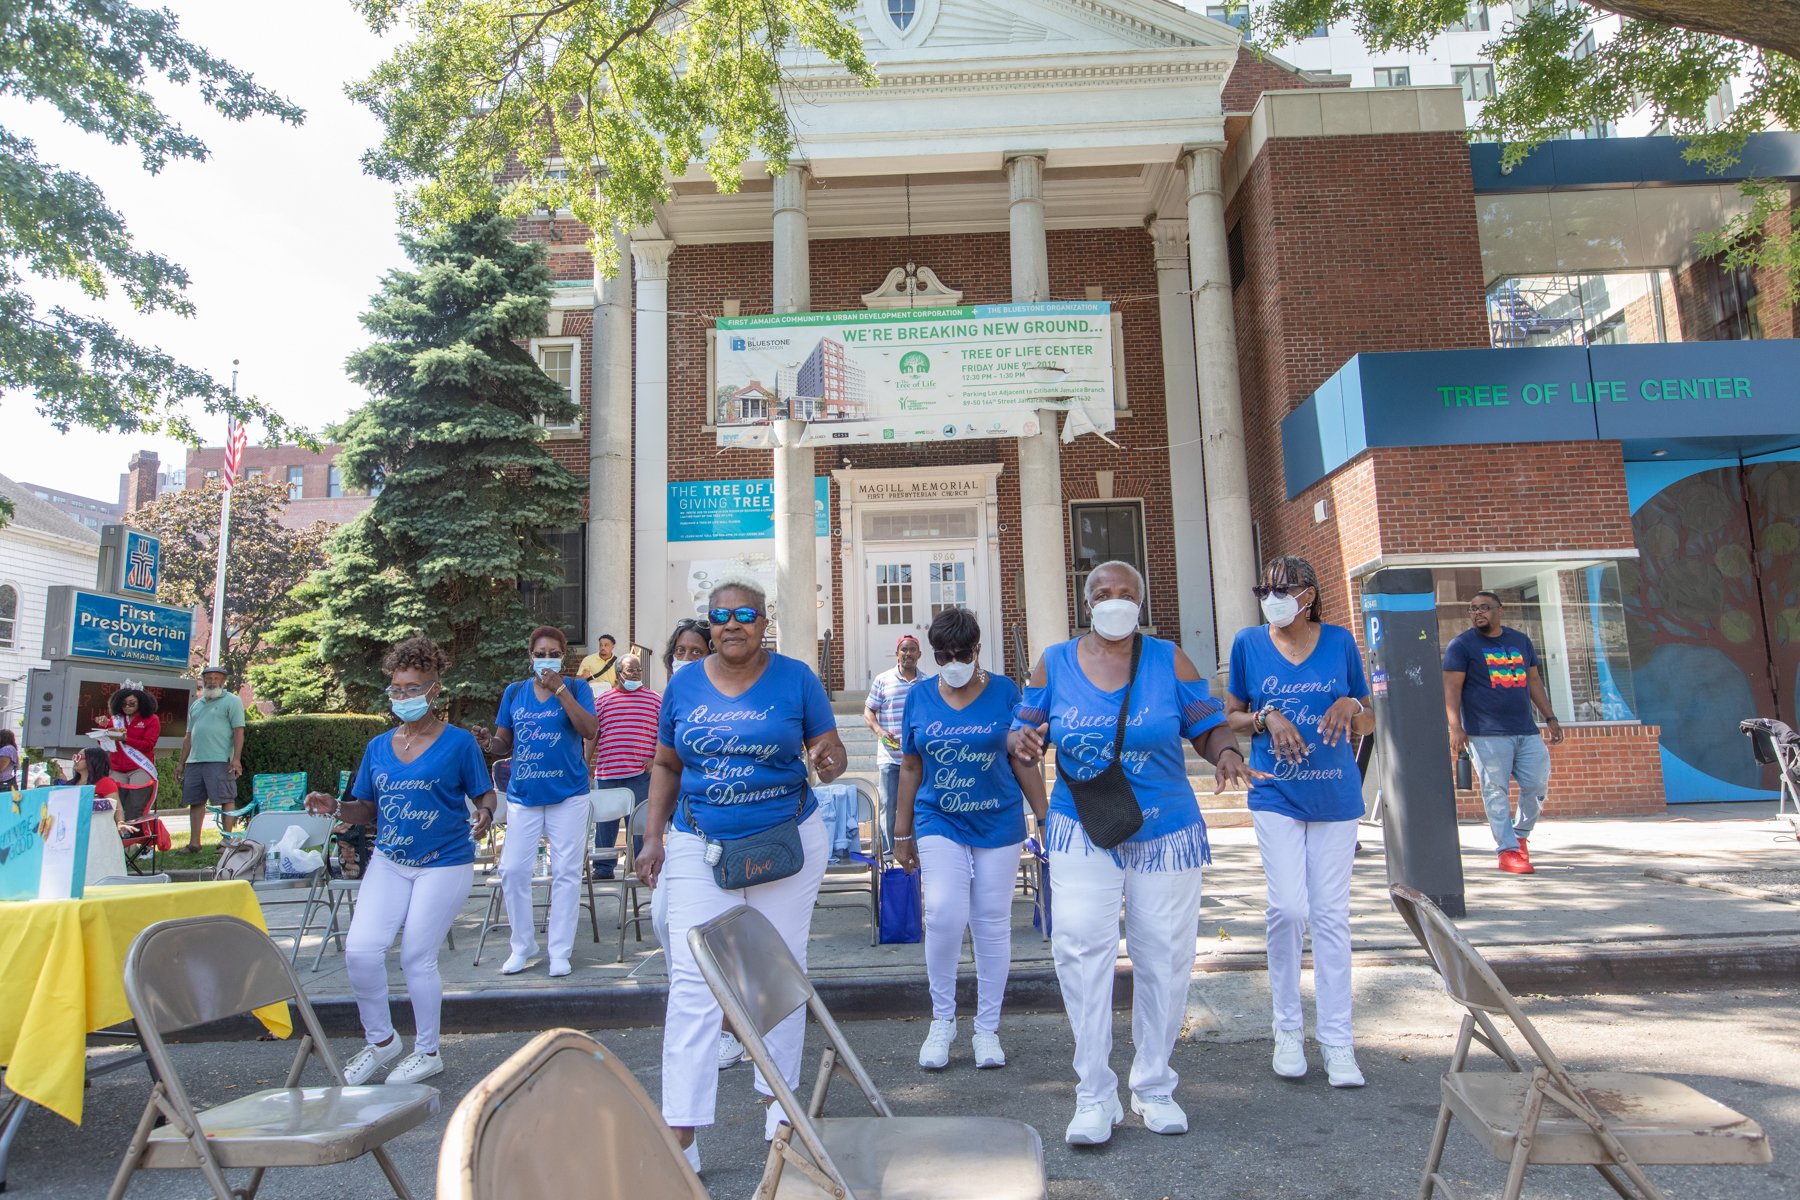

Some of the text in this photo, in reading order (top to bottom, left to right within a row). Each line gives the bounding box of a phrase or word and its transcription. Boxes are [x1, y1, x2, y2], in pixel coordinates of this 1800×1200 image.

[749, 317, 781, 325] JAMAICA
[781, 315, 824, 323] COMMUNITY
[832, 313, 858, 321] URBAN
[859, 311, 912, 320] DEVELOPMENT
[912, 309, 963, 318] CORPORATION
[1003, 305, 1045, 313] BLUESTONE
[1046, 304, 1098, 312] ORGANIZATION
[842, 319, 1103, 343] WE'RE BREAKING NEW GROUND...
[747, 338, 791, 347] BLUESTONE
[961, 345, 1093, 360] TREE OF LIFE CENTER
[961, 363, 994, 373] FRIDAY
[995, 362, 1020, 371] JUNE
[1036, 360, 1057, 369] 2017
[896, 381, 911, 389] Tree
[922, 379, 937, 388] Life
[962, 373, 980, 381] 12:30
[998, 389, 1025, 397] Adjacent
[1437, 377, 1753, 408] TREE OF LIFE CENTER
[671, 486, 698, 498] THE
[703, 485, 741, 497] TREE
[745, 484, 764, 495] OF
[858, 481, 979, 494] MAGILL MEMORIAL
[888, 491, 937, 499] PRESBYTERIAN
[679, 496, 771, 510] GIVING TREE
[933, 553, 955, 561] 8960
[119, 603, 156, 623] First
[80, 612, 186, 641] Presbyterian
[108, 632, 162, 653] Church
[106, 648, 161, 663] IN JAMAICA
[1261, 675, 1336, 696] Queens'
[513, 706, 563, 720] Queens'
[687, 704, 775, 724] Queens'
[511, 720, 562, 748] Ebony
[925, 720, 998, 738] Queens'
[516, 744, 544, 762] Line
[682, 725, 780, 763] Ebony
[1061, 732, 1152, 775] Ebny
[925, 738, 997, 772] Ebony
[516, 762, 564, 781] Dancer
[700, 755, 755, 781] Line
[1273, 758, 1344, 781] Dancer
[375, 772, 440, 793] Queens'
[934, 767, 976, 790] Line
[705, 780, 788, 806] Dancer
[939, 791, 1000, 813] Dancer
[378, 793, 440, 830] Ebony
[378, 824, 414, 847] Line
[745, 857, 774, 880] love
